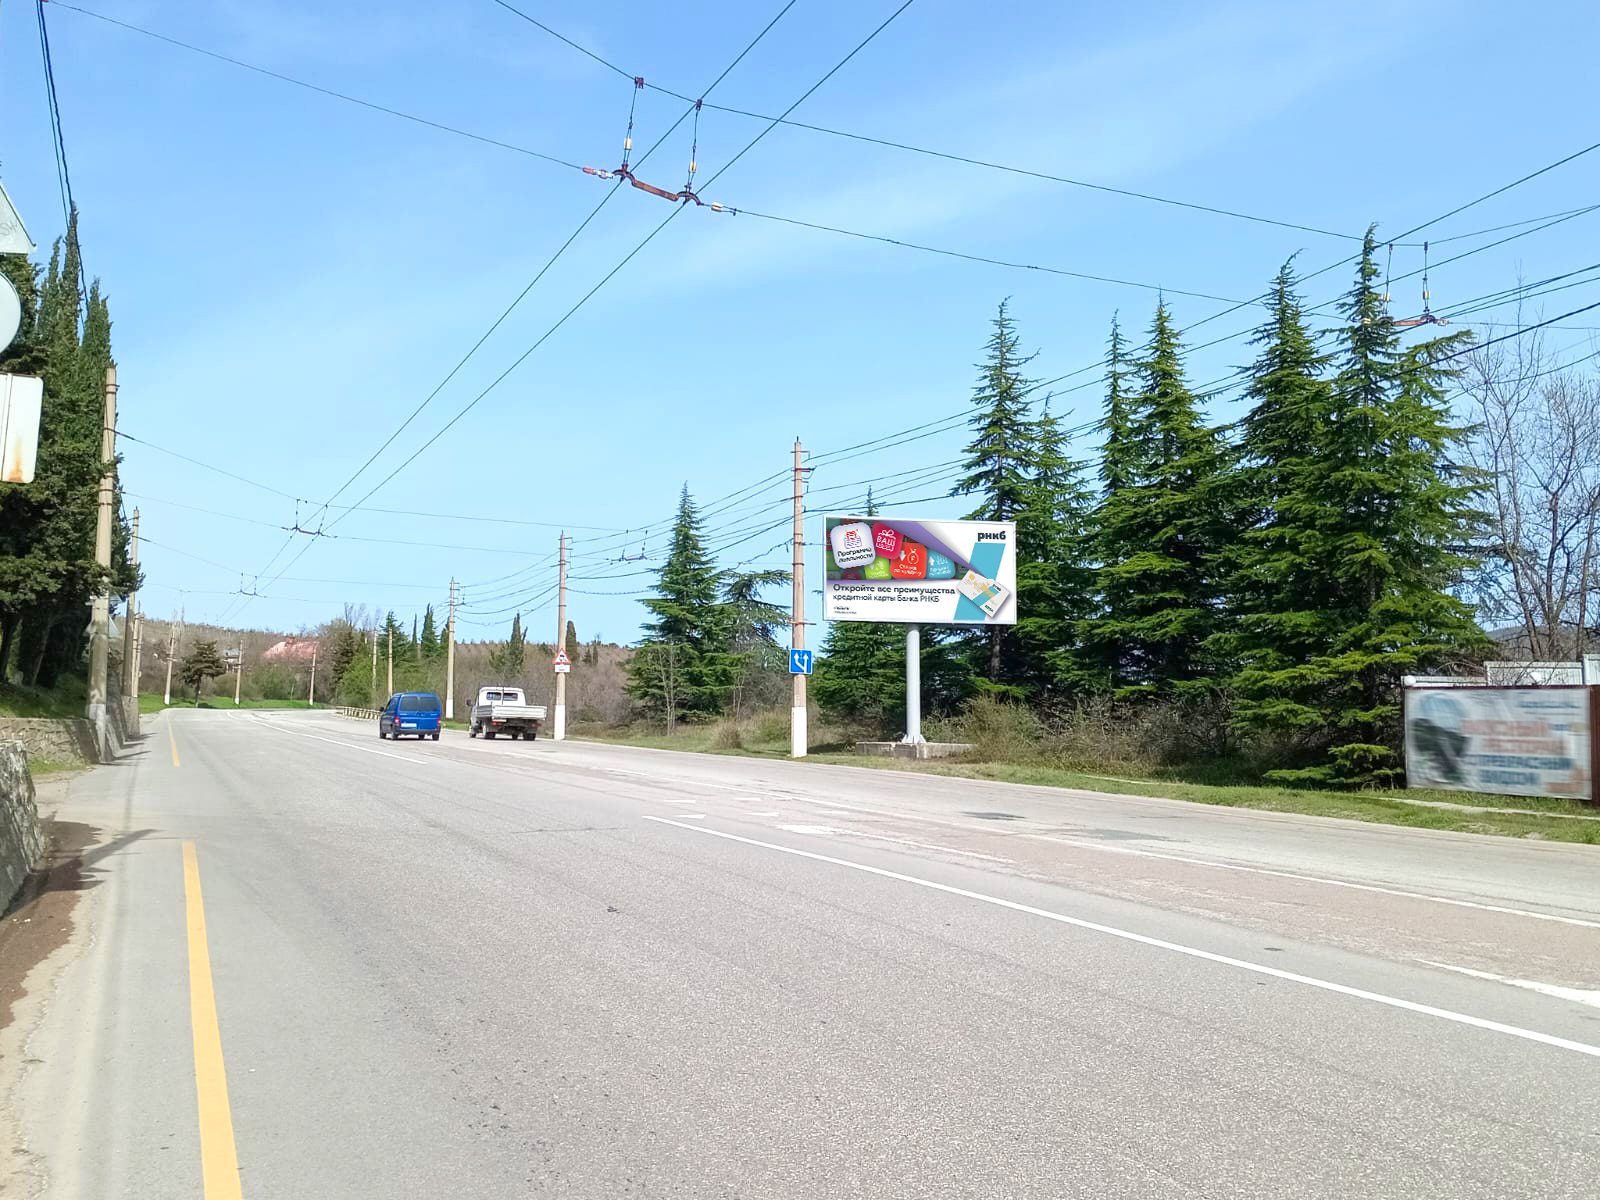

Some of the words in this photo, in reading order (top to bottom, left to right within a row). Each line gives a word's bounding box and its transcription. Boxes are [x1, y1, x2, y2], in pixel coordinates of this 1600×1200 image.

[978, 531, 1006, 541] рнкб
[833, 583, 876, 593] Откройте
[893, 587, 956, 595] преимущества
